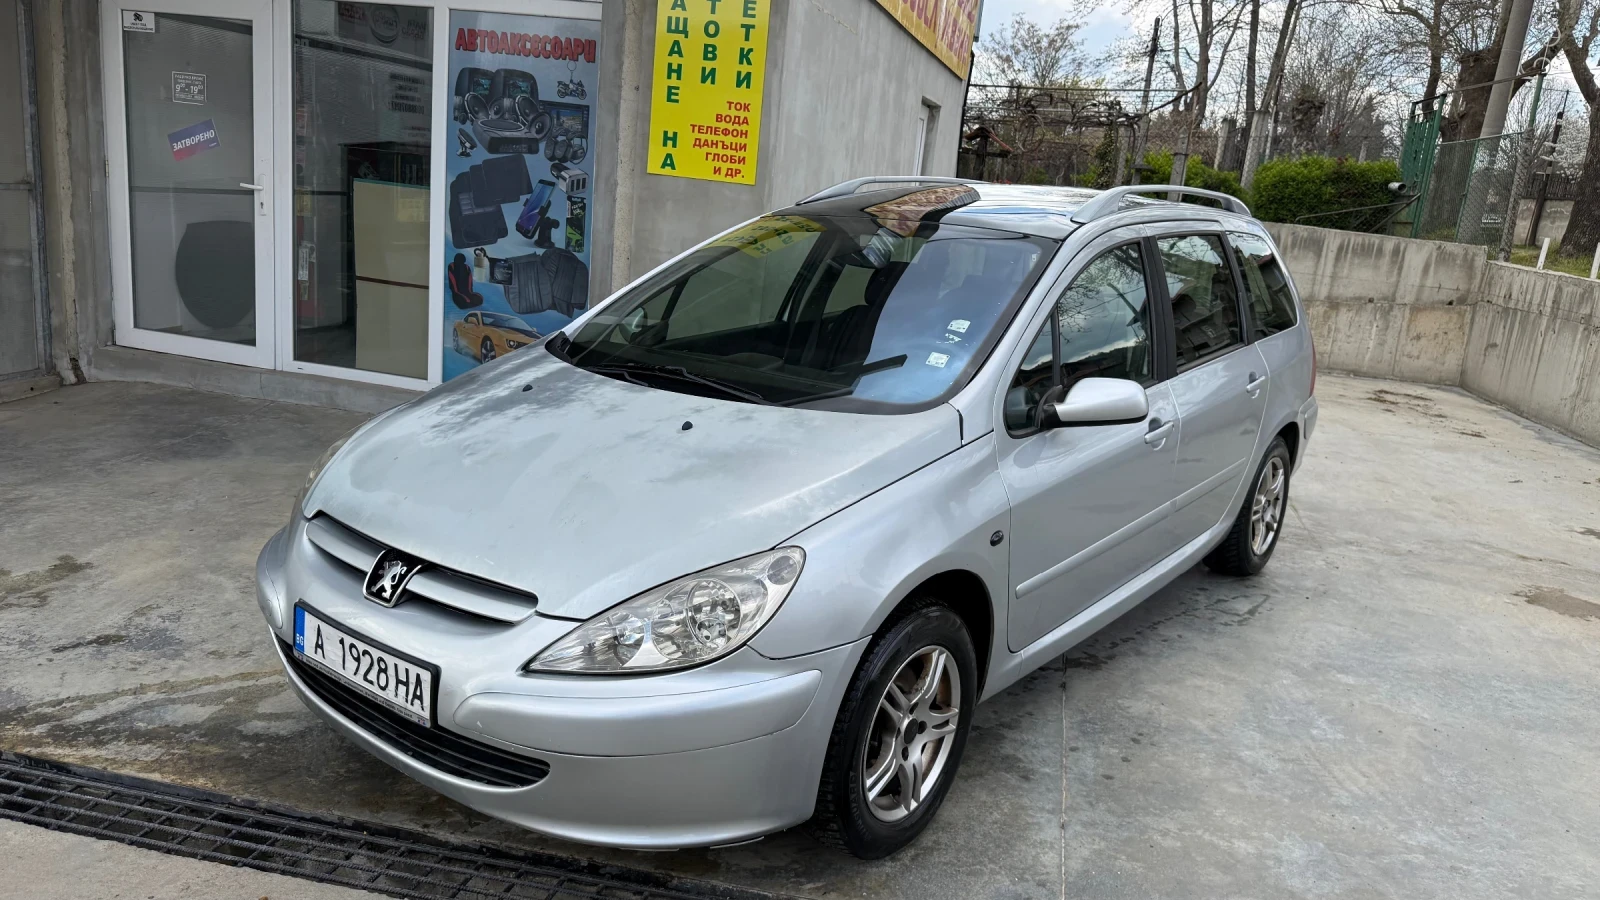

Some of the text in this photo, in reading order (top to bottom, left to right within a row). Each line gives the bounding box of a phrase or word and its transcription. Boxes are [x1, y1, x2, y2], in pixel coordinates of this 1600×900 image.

[455, 27, 596, 63] АВТОАКСЕСОАРИ
[726, 101, 750, 112] ТОК
[715, 113, 749, 126] ВОДА
[690, 124, 748, 138] ТЕЛЕФОН
[172, 129, 215, 151] ЗАТВОРЕНО
[693, 138, 747, 153] ДАНЪЦИ
[660, 130, 678, 170] НА
[705, 152, 746, 165] ГЛОБИ
[713, 166, 745, 179] И ДР.
[339, 637, 389, 692] 1928
